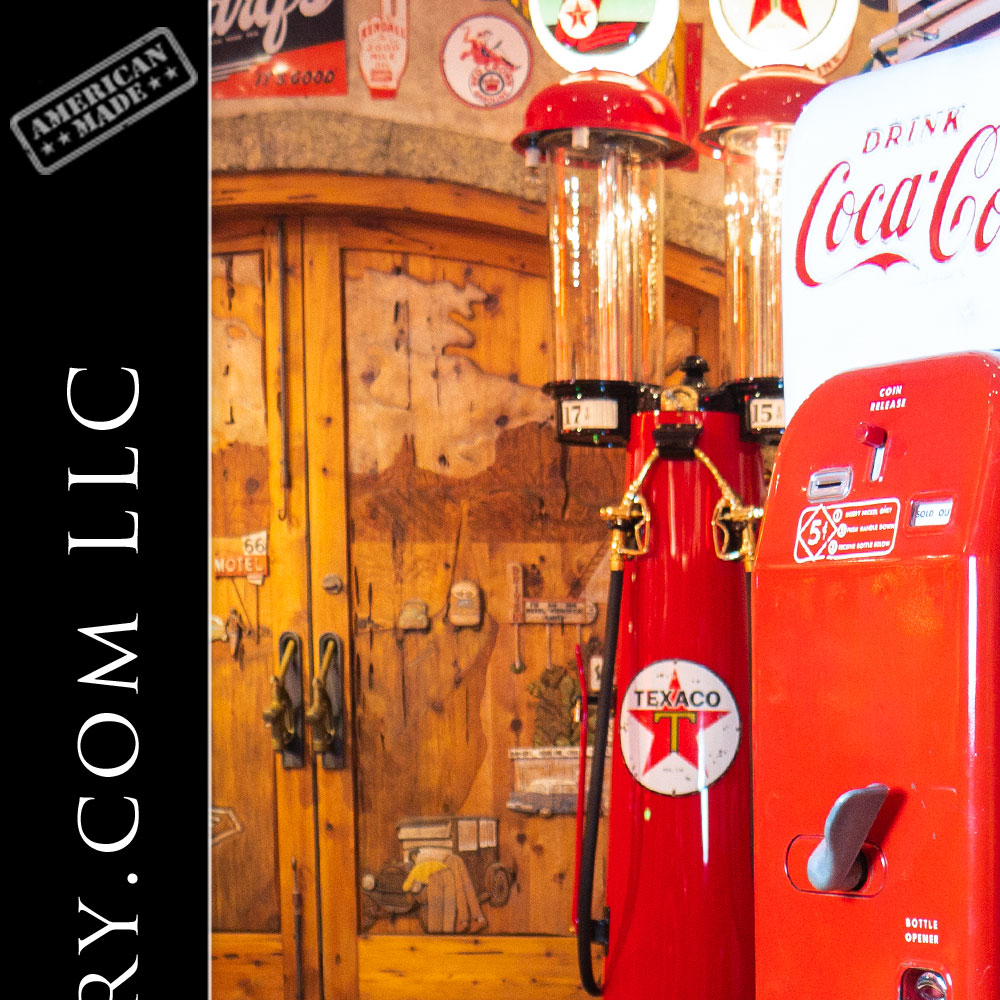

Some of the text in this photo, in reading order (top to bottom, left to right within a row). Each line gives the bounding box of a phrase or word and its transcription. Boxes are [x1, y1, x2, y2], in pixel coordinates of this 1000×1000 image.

[289, 70, 335, 85] GOOD
[862, 106, 965, 154] DRINK
[879, 385, 902, 398] COIN
[870, 398, 907, 412] RELEASE
[915, 509, 934, 518] SOLD
[244, 538, 266, 554] 66
[214, 555, 265, 573] MOTEL
[634, 690, 722, 708] TEXACO
[905, 917, 938, 930] BOTTLE
[904, 932, 939, 945] OPENER
